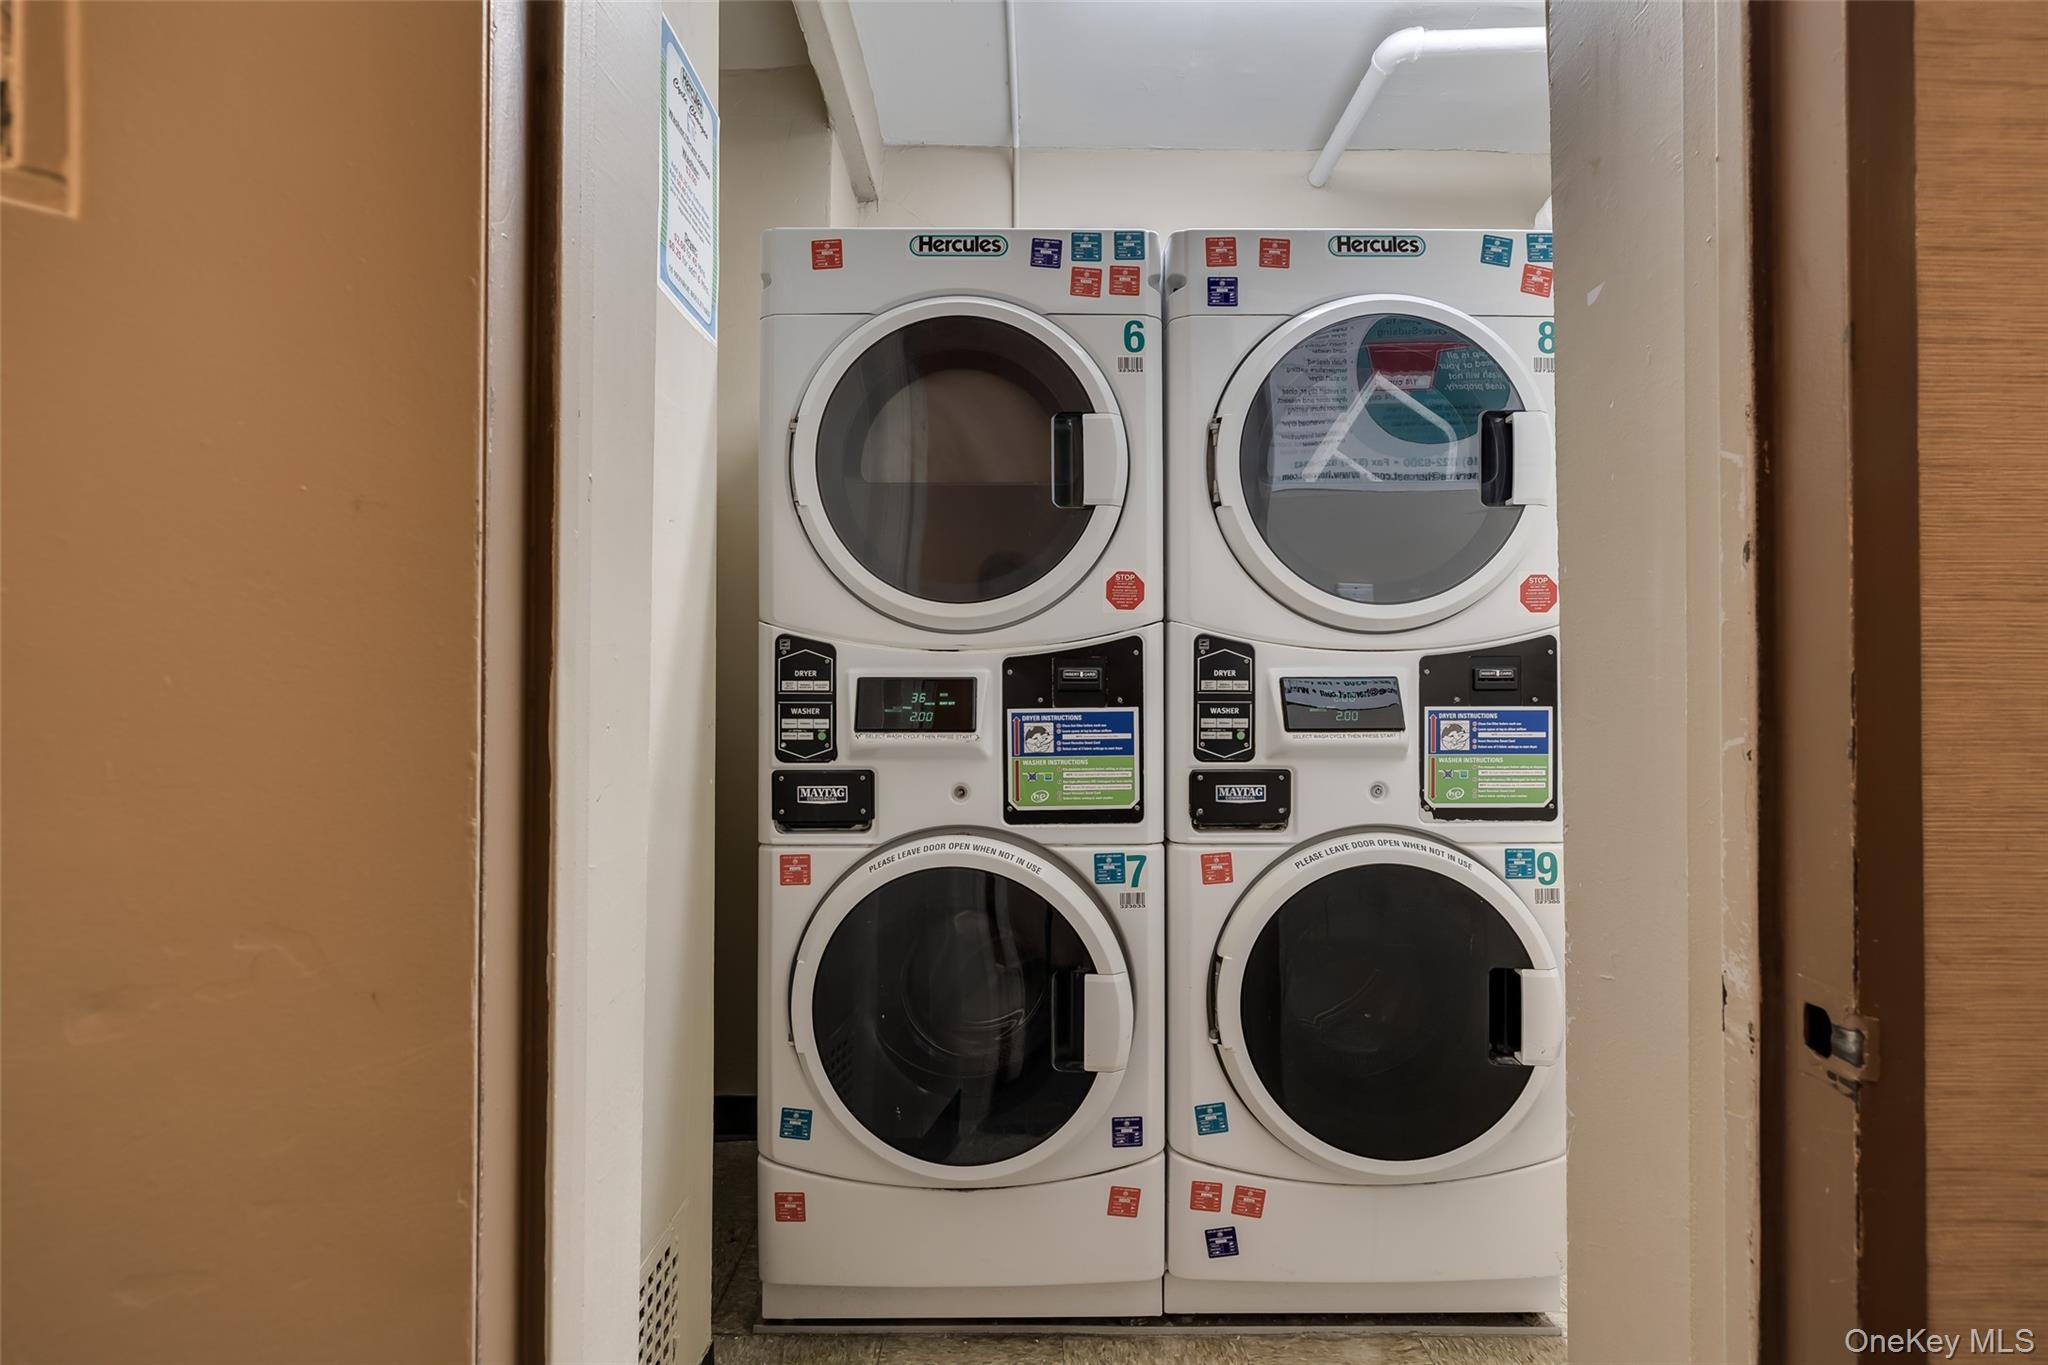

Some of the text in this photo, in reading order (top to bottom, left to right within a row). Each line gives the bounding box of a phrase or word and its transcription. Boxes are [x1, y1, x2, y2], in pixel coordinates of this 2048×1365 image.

[919, 236, 1002, 252] Hercules
[1337, 236, 1420, 253] Hercules
[1124, 320, 1145, 353] 6
[1538, 321, 1555, 353] 8
[1213, 669, 1237, 677] DRYER
[912, 692, 927, 704] 36
[790, 707, 821, 715] WASHER
[910, 711, 934, 722] 2.00
[1209, 706, 1240, 715] WASHER
[1335, 710, 1359, 721] 2.00
[800, 788, 845, 797] MAYTAG
[1218, 787, 1263, 797] MAYTAG
[868, 842, 1043, 876] PLEASE LEAVE DOOR OPEN WHEN NOT IN USE
[1294, 839, 1473, 871] PLEASE LEAVE DOOR OPEN WHEN NOT IN USE
[1126, 855, 1147, 888] 7
[1537, 852, 1558, 886] 9
